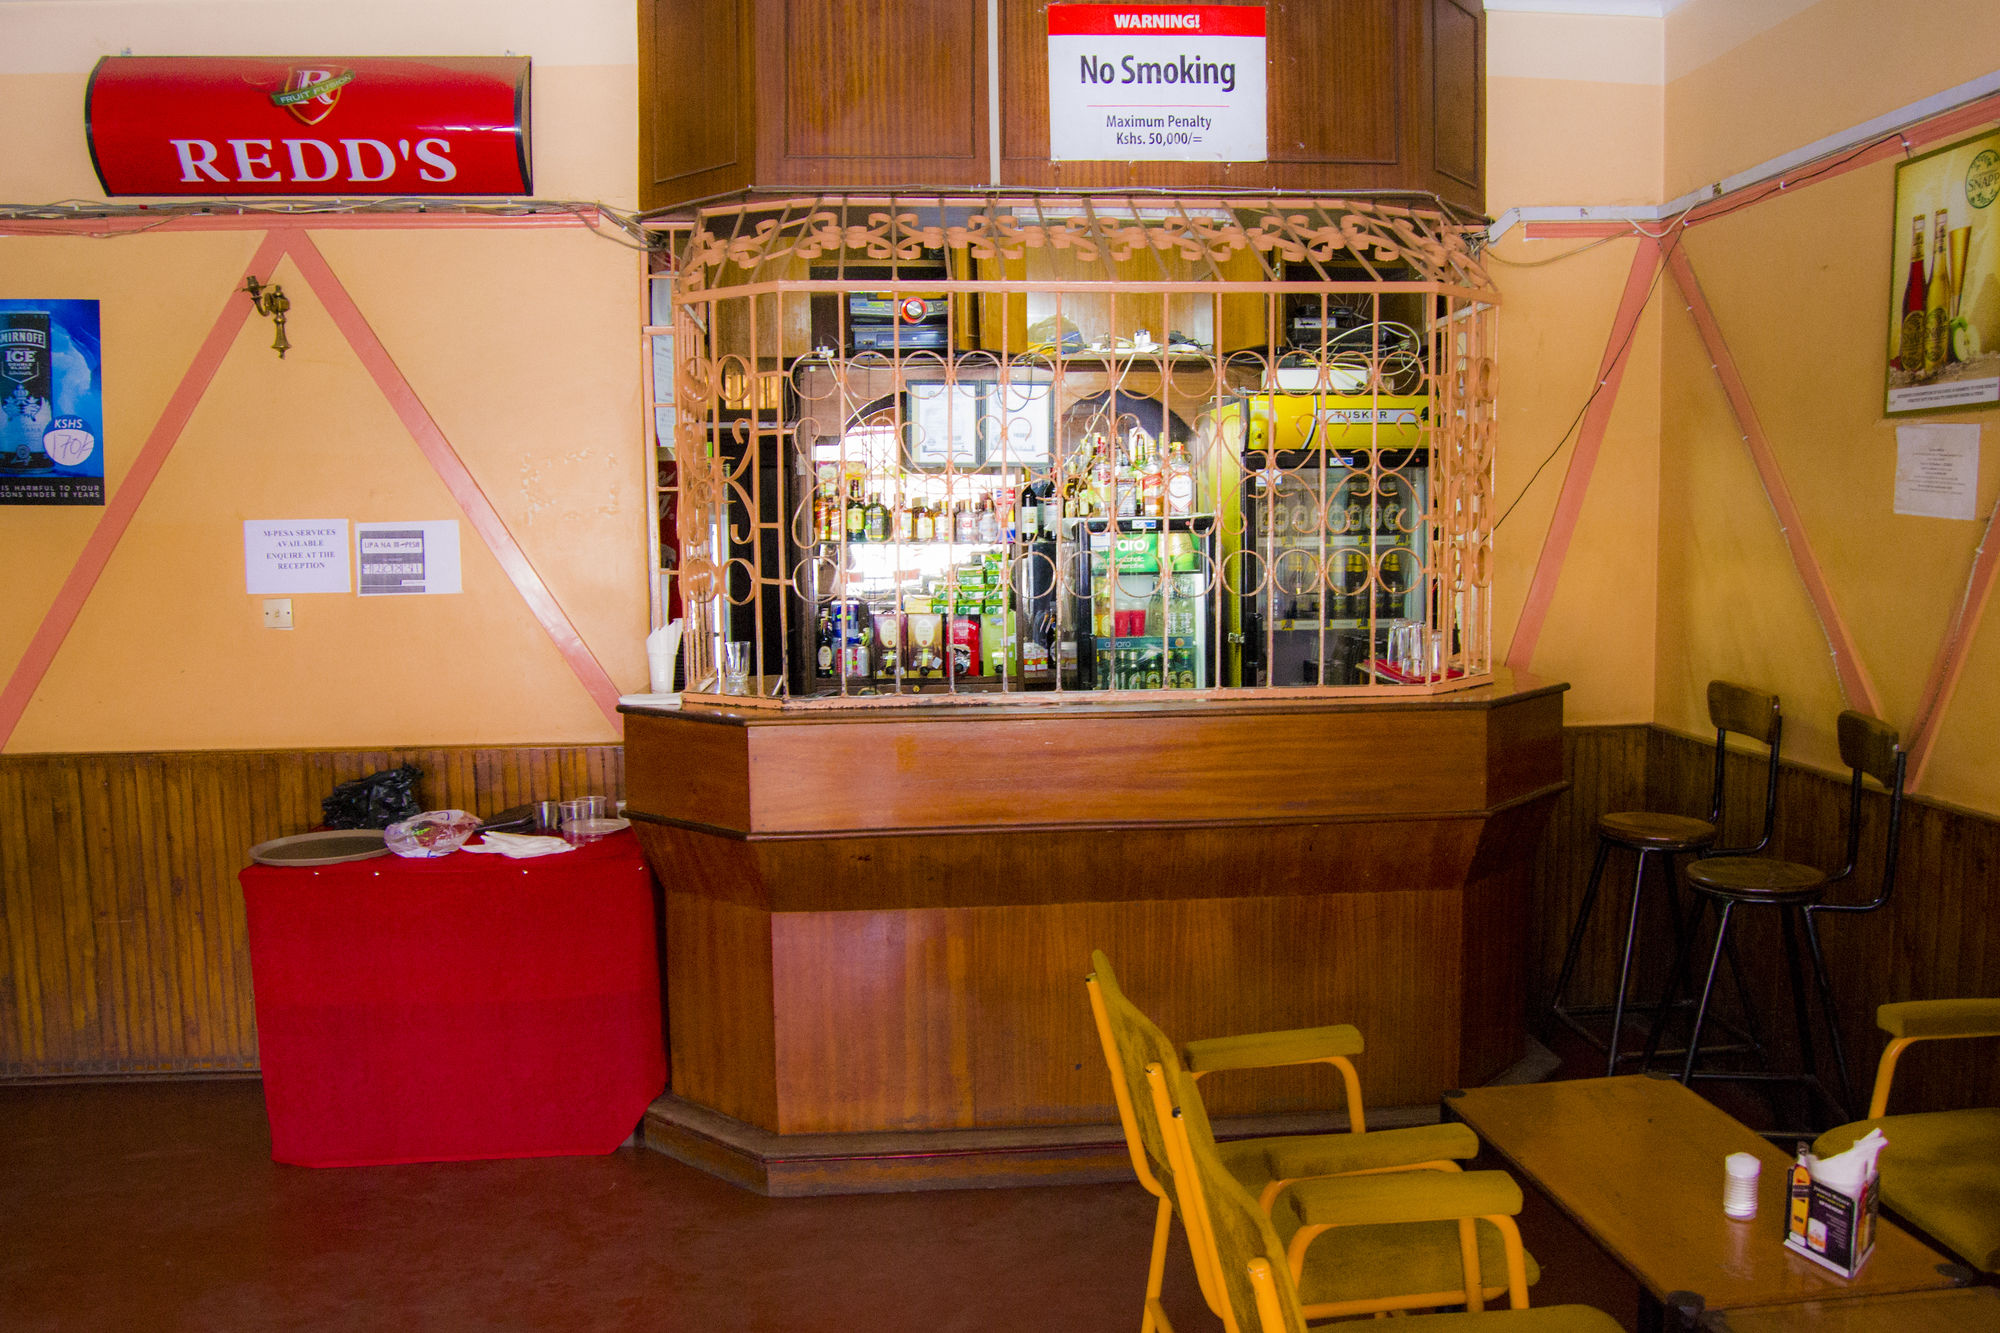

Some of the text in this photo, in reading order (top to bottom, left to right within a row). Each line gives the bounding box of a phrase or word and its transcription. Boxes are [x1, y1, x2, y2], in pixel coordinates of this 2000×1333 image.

[1114, 14, 1200, 29] WARNING!
[1080, 54, 1236, 93] No Smoking
[279, 90, 310, 105] FRUIT
[1106, 115, 1212, 130] Maximum Penalty
[1116, 132, 1203, 147] Kshs. 50,000/=
[170, 138, 458, 183] REDD'S
[5, 350, 36, 362] ICE
[54, 419, 83, 429] KSHS
[296, 528, 336, 536] SERVICES
[277, 539, 324, 547] AVAILABLE
[266, 552, 303, 560] ENQUIRE
